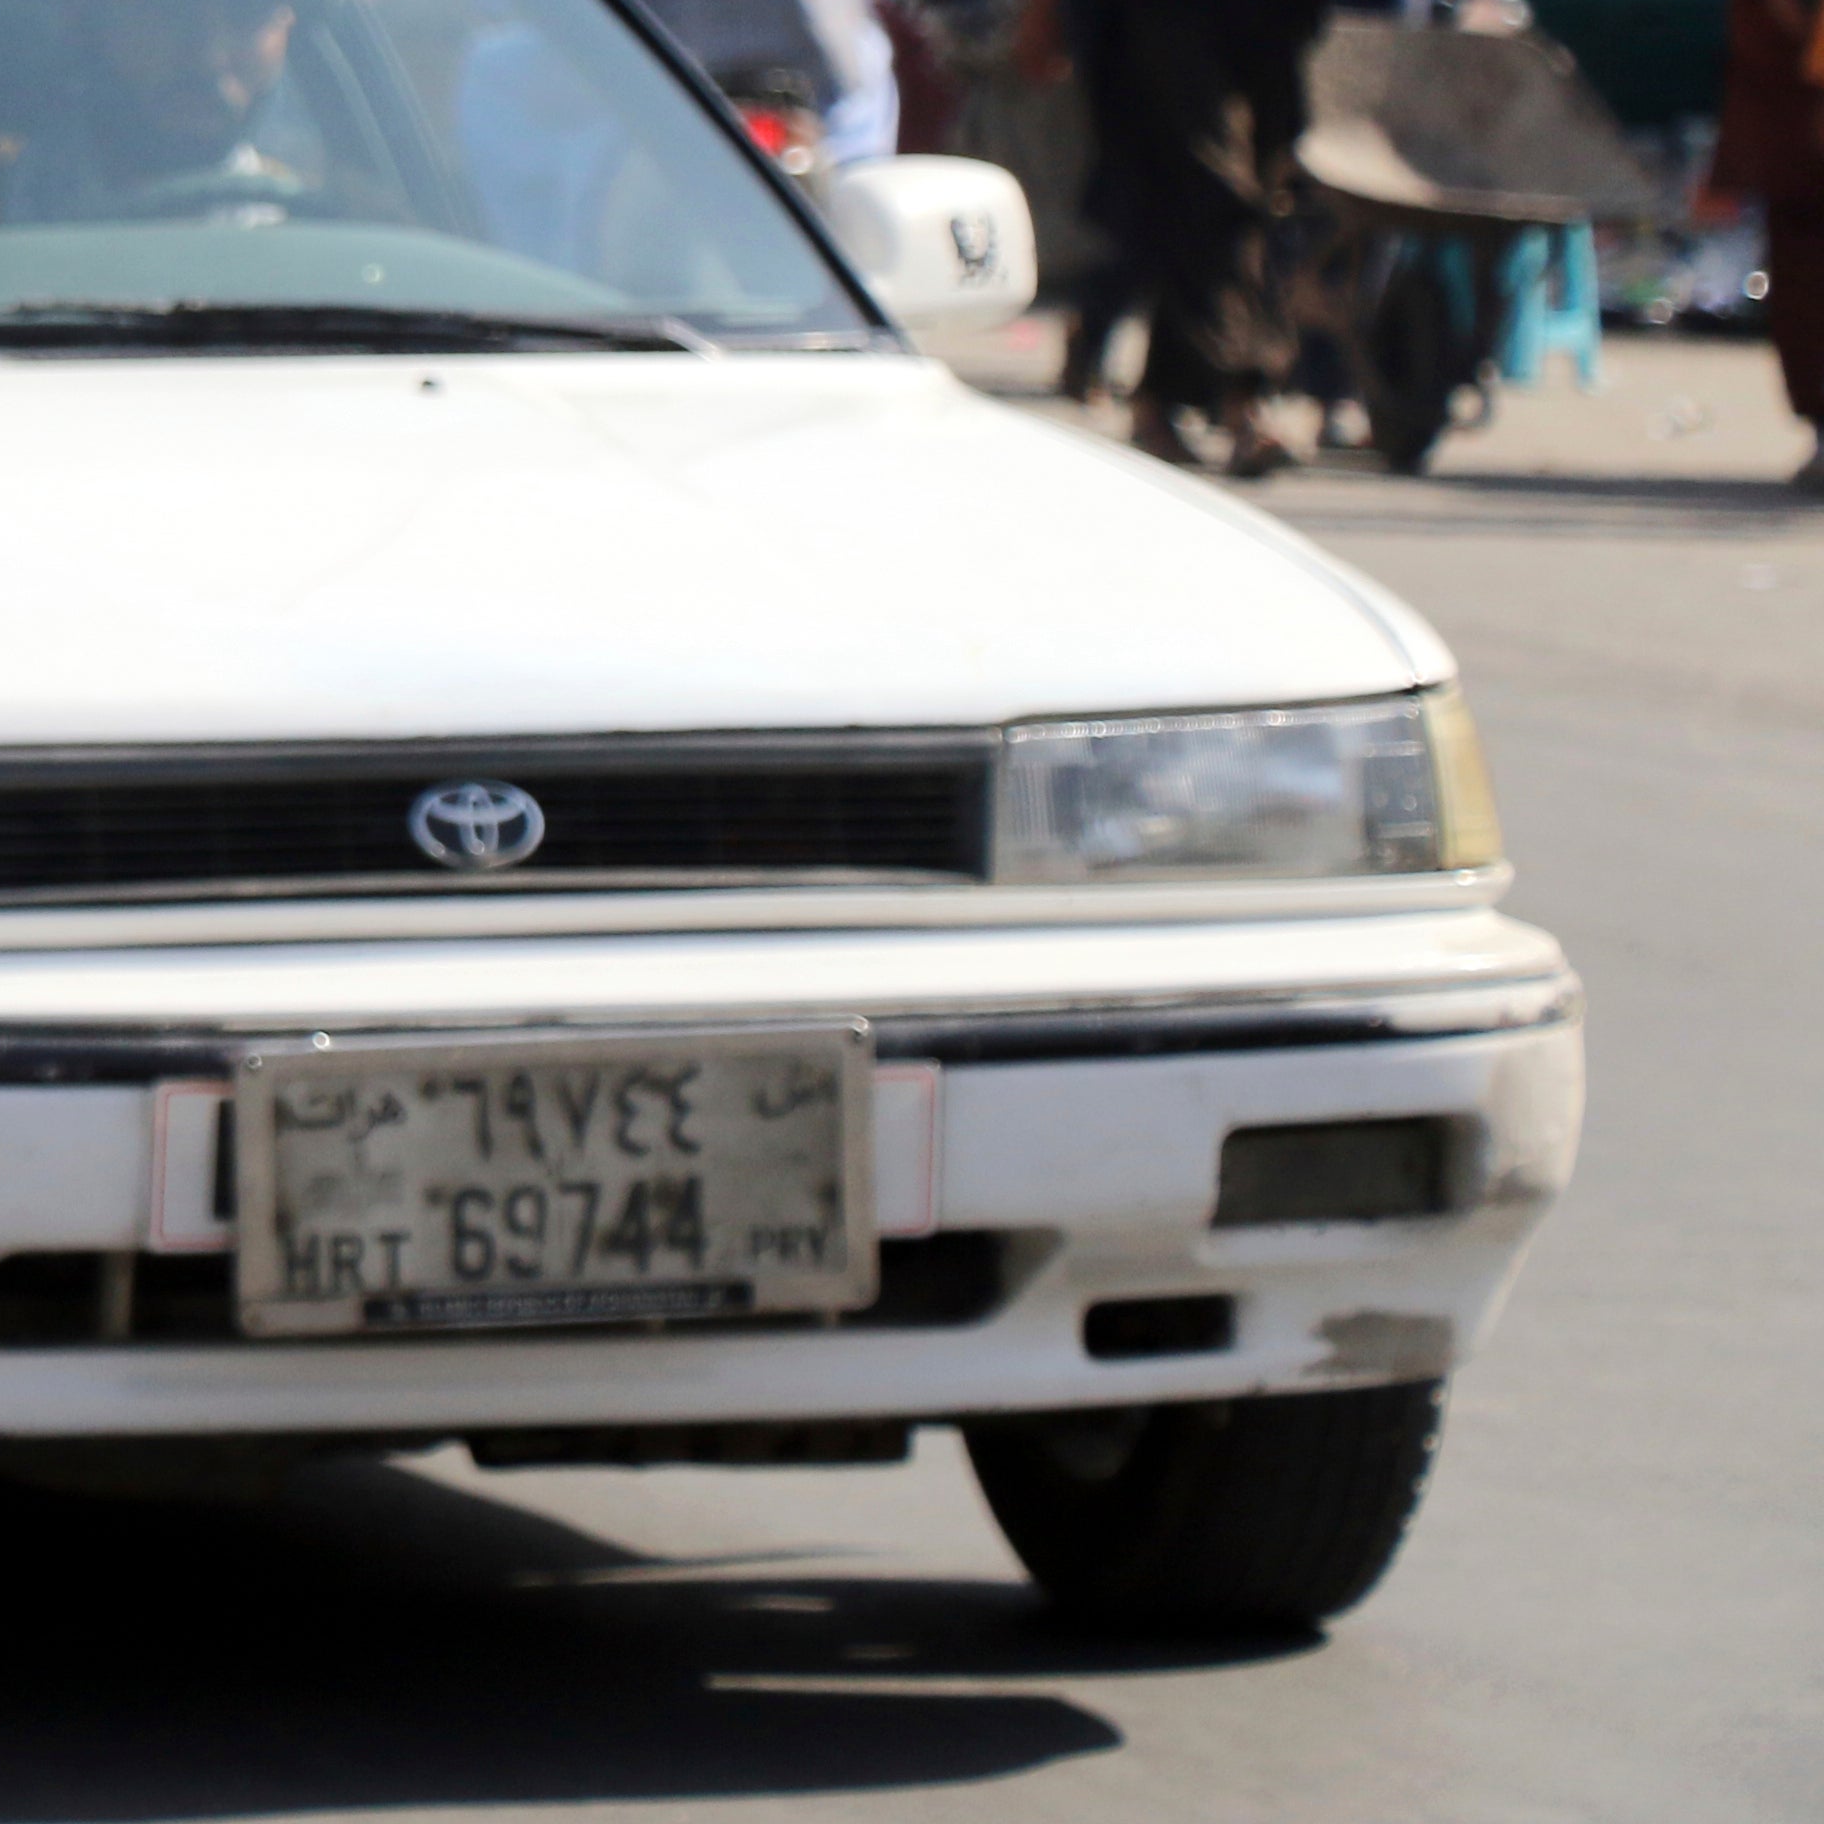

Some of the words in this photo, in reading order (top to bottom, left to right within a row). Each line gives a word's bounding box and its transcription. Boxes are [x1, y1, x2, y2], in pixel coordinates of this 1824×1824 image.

[274, 1087, 408, 1143] هرات
[454, 1068, 705, 1161] ٦٩٧٤٤
[284, 1233, 410, 1294] HRT
[452, 1179, 709, 1280] 69744
